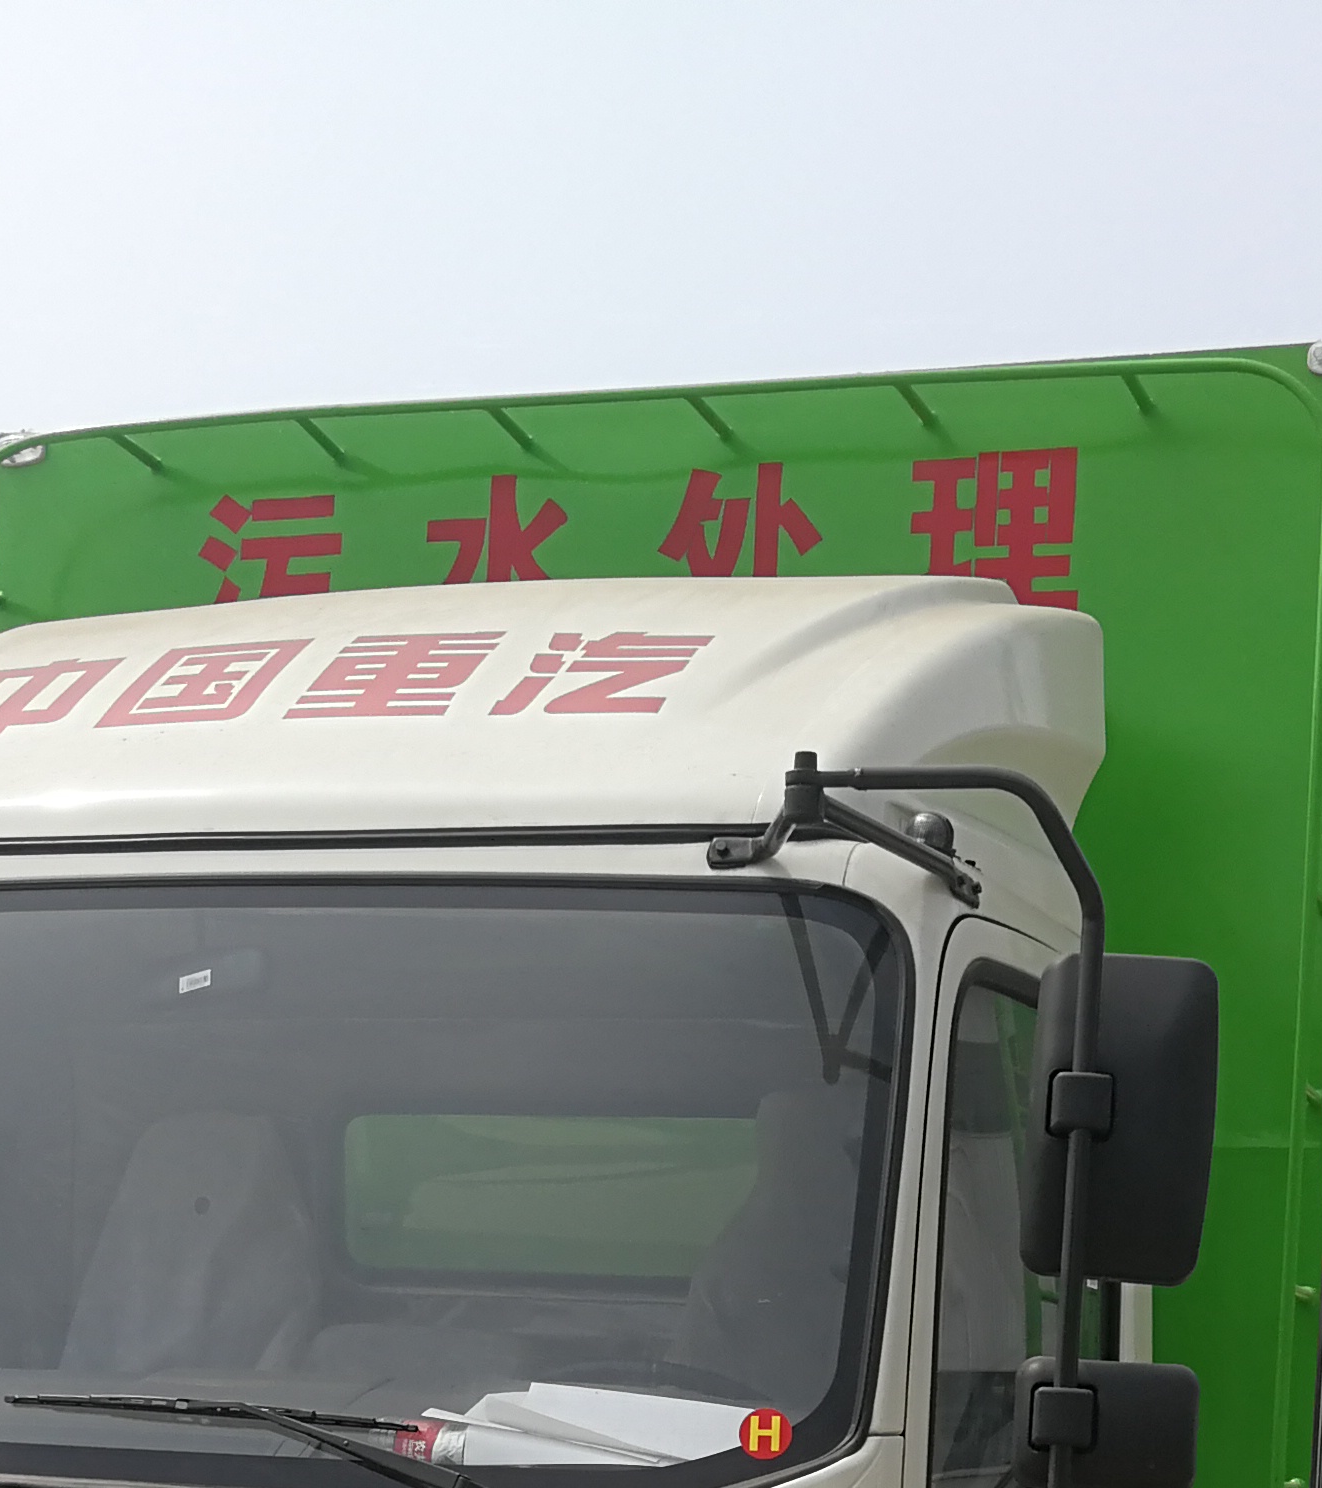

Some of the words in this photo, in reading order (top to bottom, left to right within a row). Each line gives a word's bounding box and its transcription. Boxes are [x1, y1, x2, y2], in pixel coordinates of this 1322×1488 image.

[198, 447, 1077, 611] 污水处理
[748, 1415, 781, 1452] H
